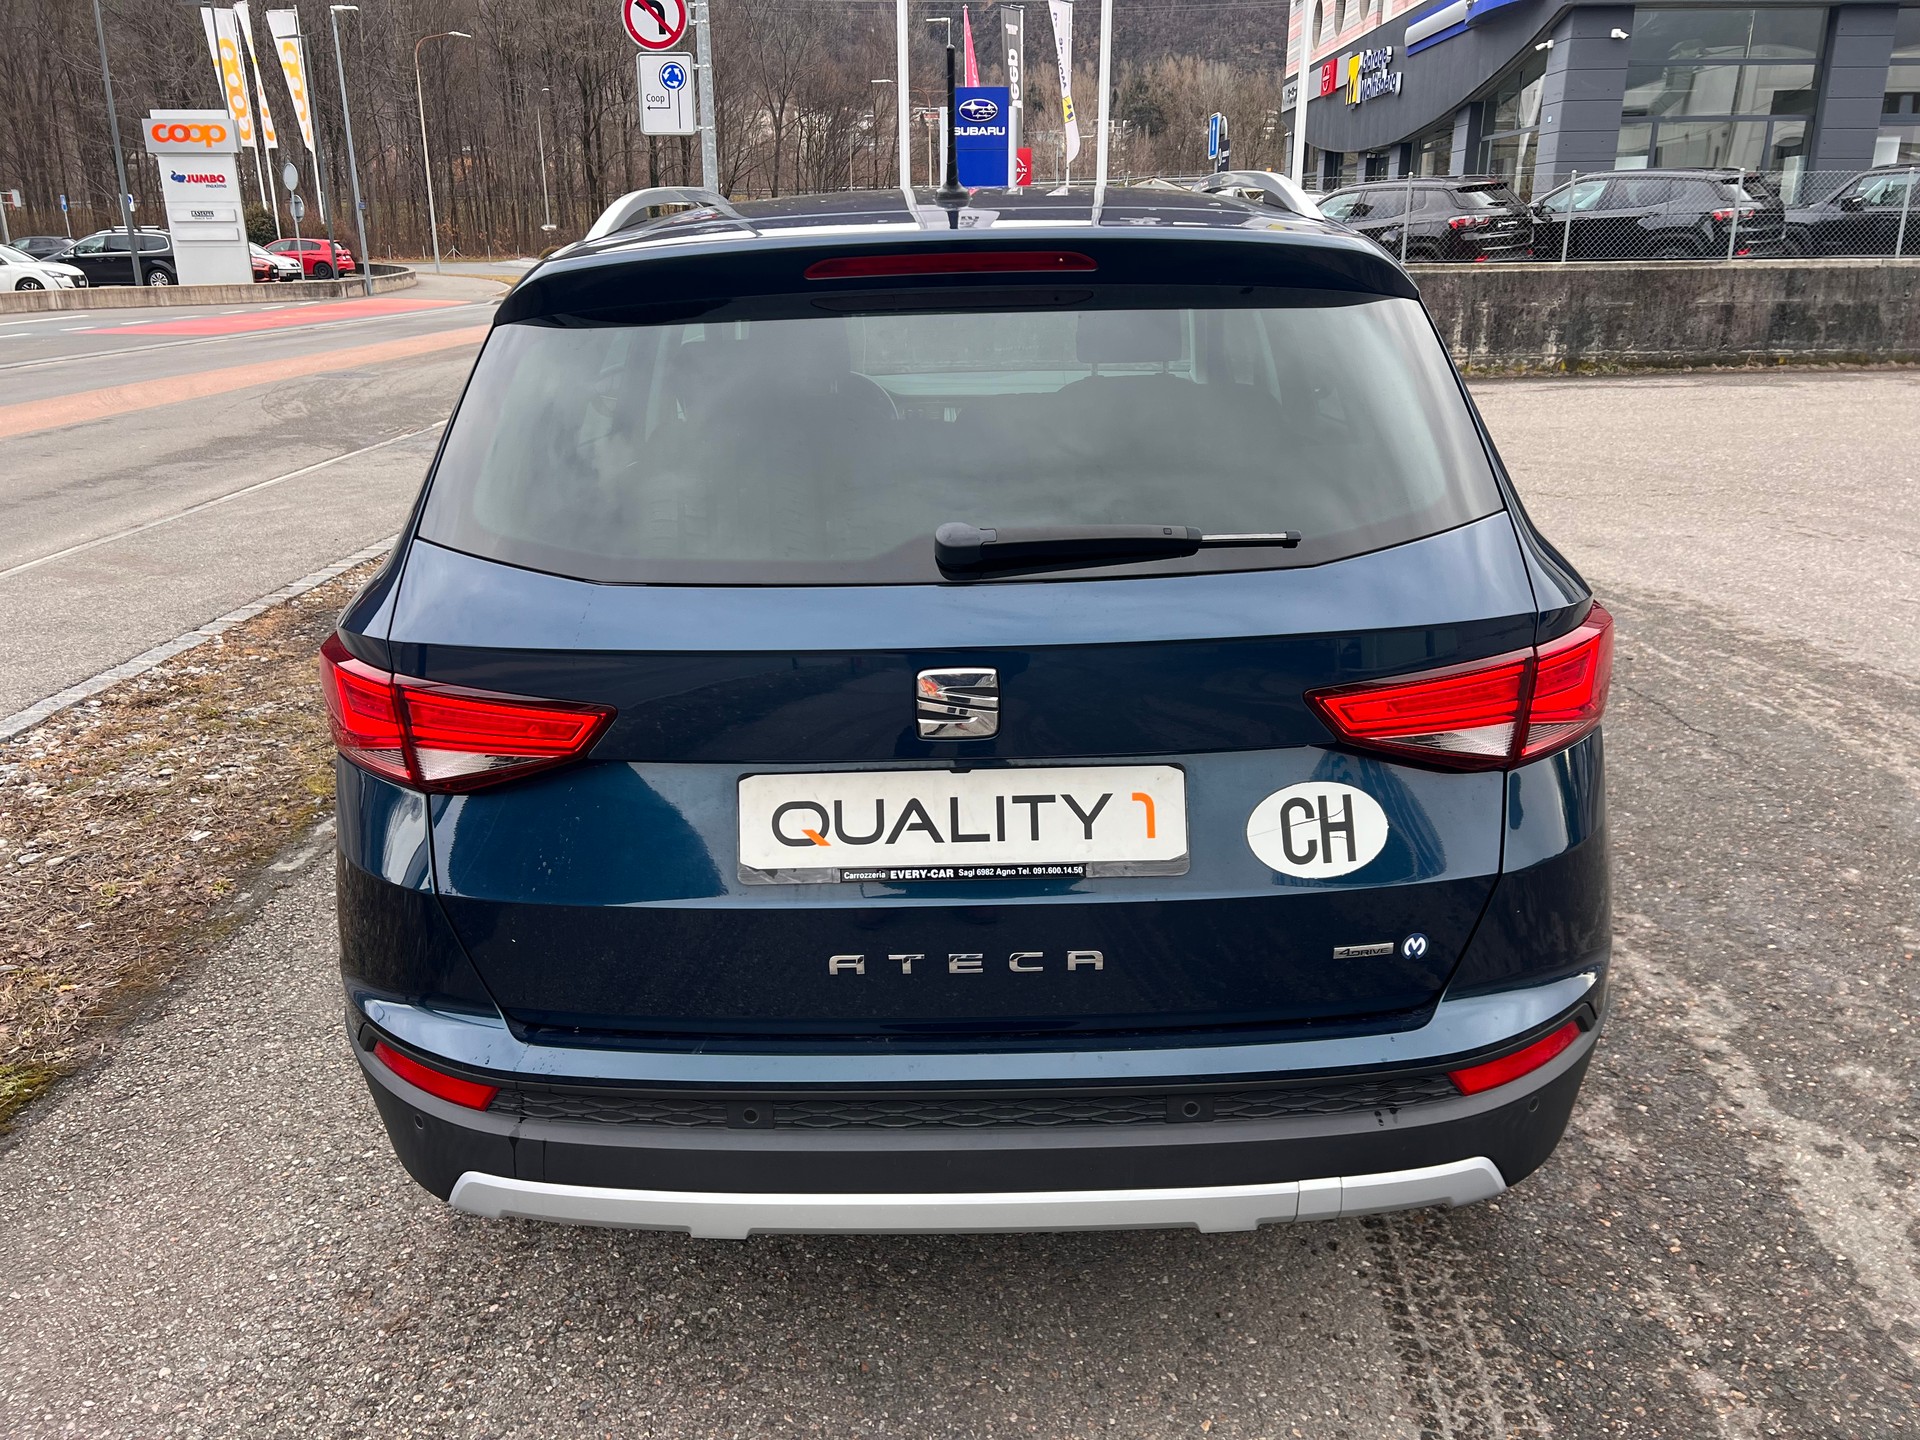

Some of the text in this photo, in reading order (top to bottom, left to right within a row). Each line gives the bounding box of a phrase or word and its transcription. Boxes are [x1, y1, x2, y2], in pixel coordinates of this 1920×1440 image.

[646, 93, 665, 104] Coop
[151, 123, 227, 148] coop
[954, 126, 1006, 136] SUBARU
[185, 174, 226, 184] JUMBO
[771, 792, 1156, 847] QUALITY 1
[1280, 793, 1357, 866] CH
[843, 870, 886, 880] Carrozzeria
[890, 868, 954, 880] EVERY-CAR
[976, 868, 994, 876] 6982
[995, 867, 1016, 877] Agno
[1017, 866, 1031, 875] Tel.
[1033, 866, 1083, 874] 091.600.14.50
[1338, 946, 1391, 958] 4DRIVE
[828, 950, 1104, 976] ATECA
